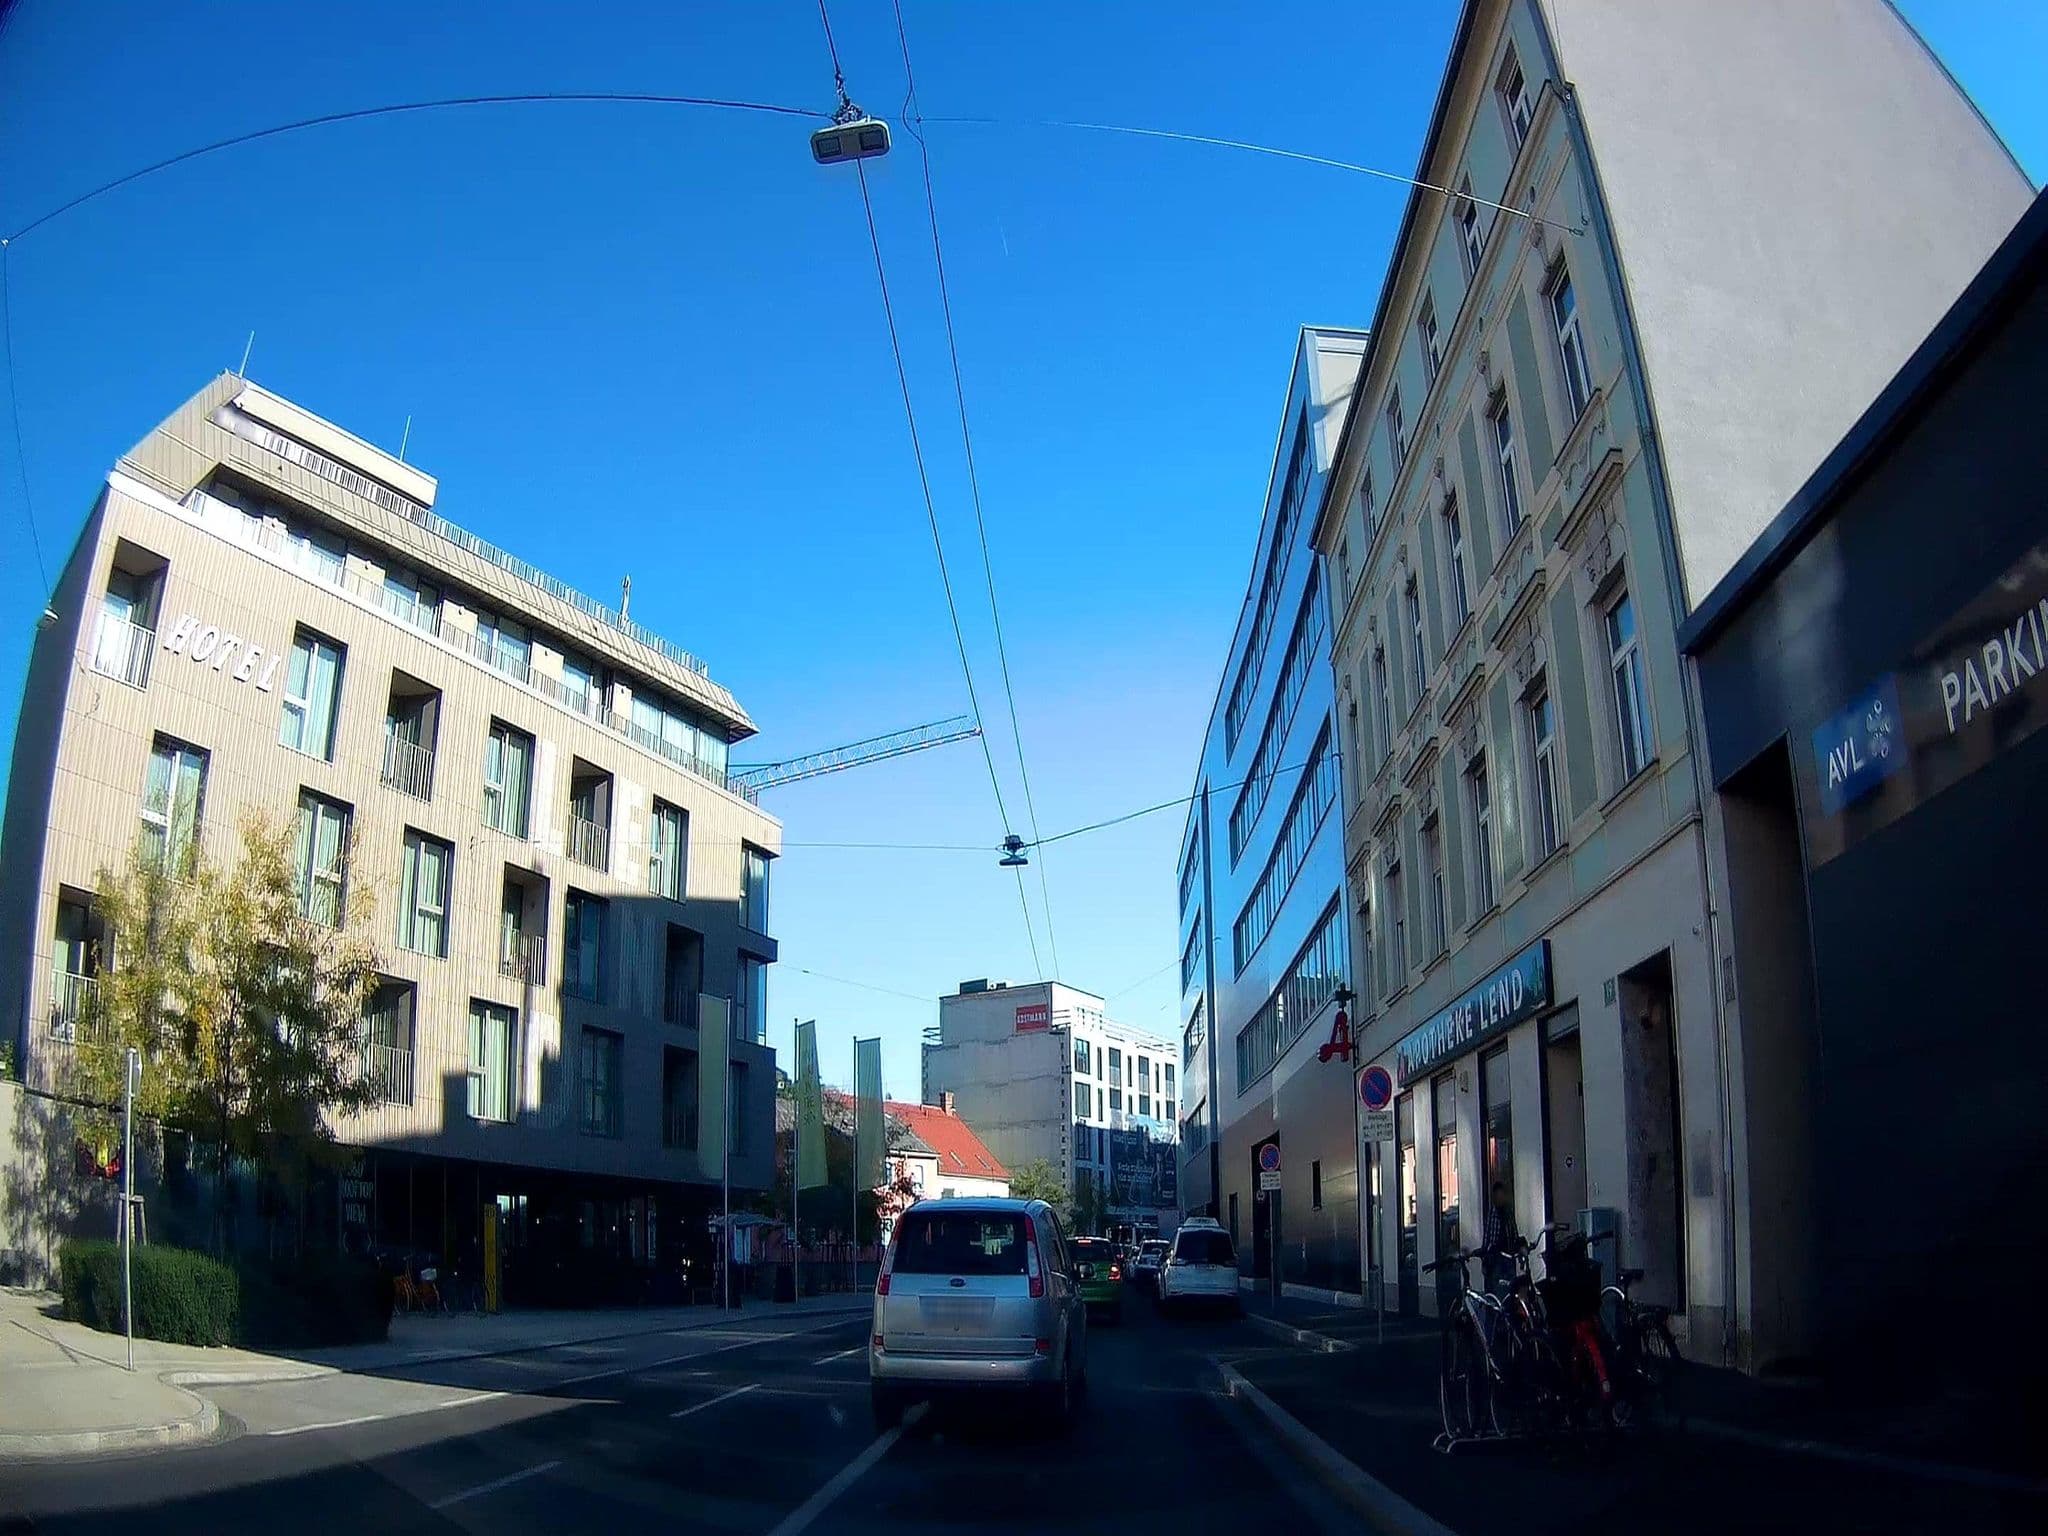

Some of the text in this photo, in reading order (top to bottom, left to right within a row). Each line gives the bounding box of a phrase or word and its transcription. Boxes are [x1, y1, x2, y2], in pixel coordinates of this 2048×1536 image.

[163, 614, 280, 693] HOTEL
[1828, 737, 1864, 790] AVL
[1407, 1000, 1473, 1074] APOTHEKE
[1479, 969, 1524, 1030] LEND
